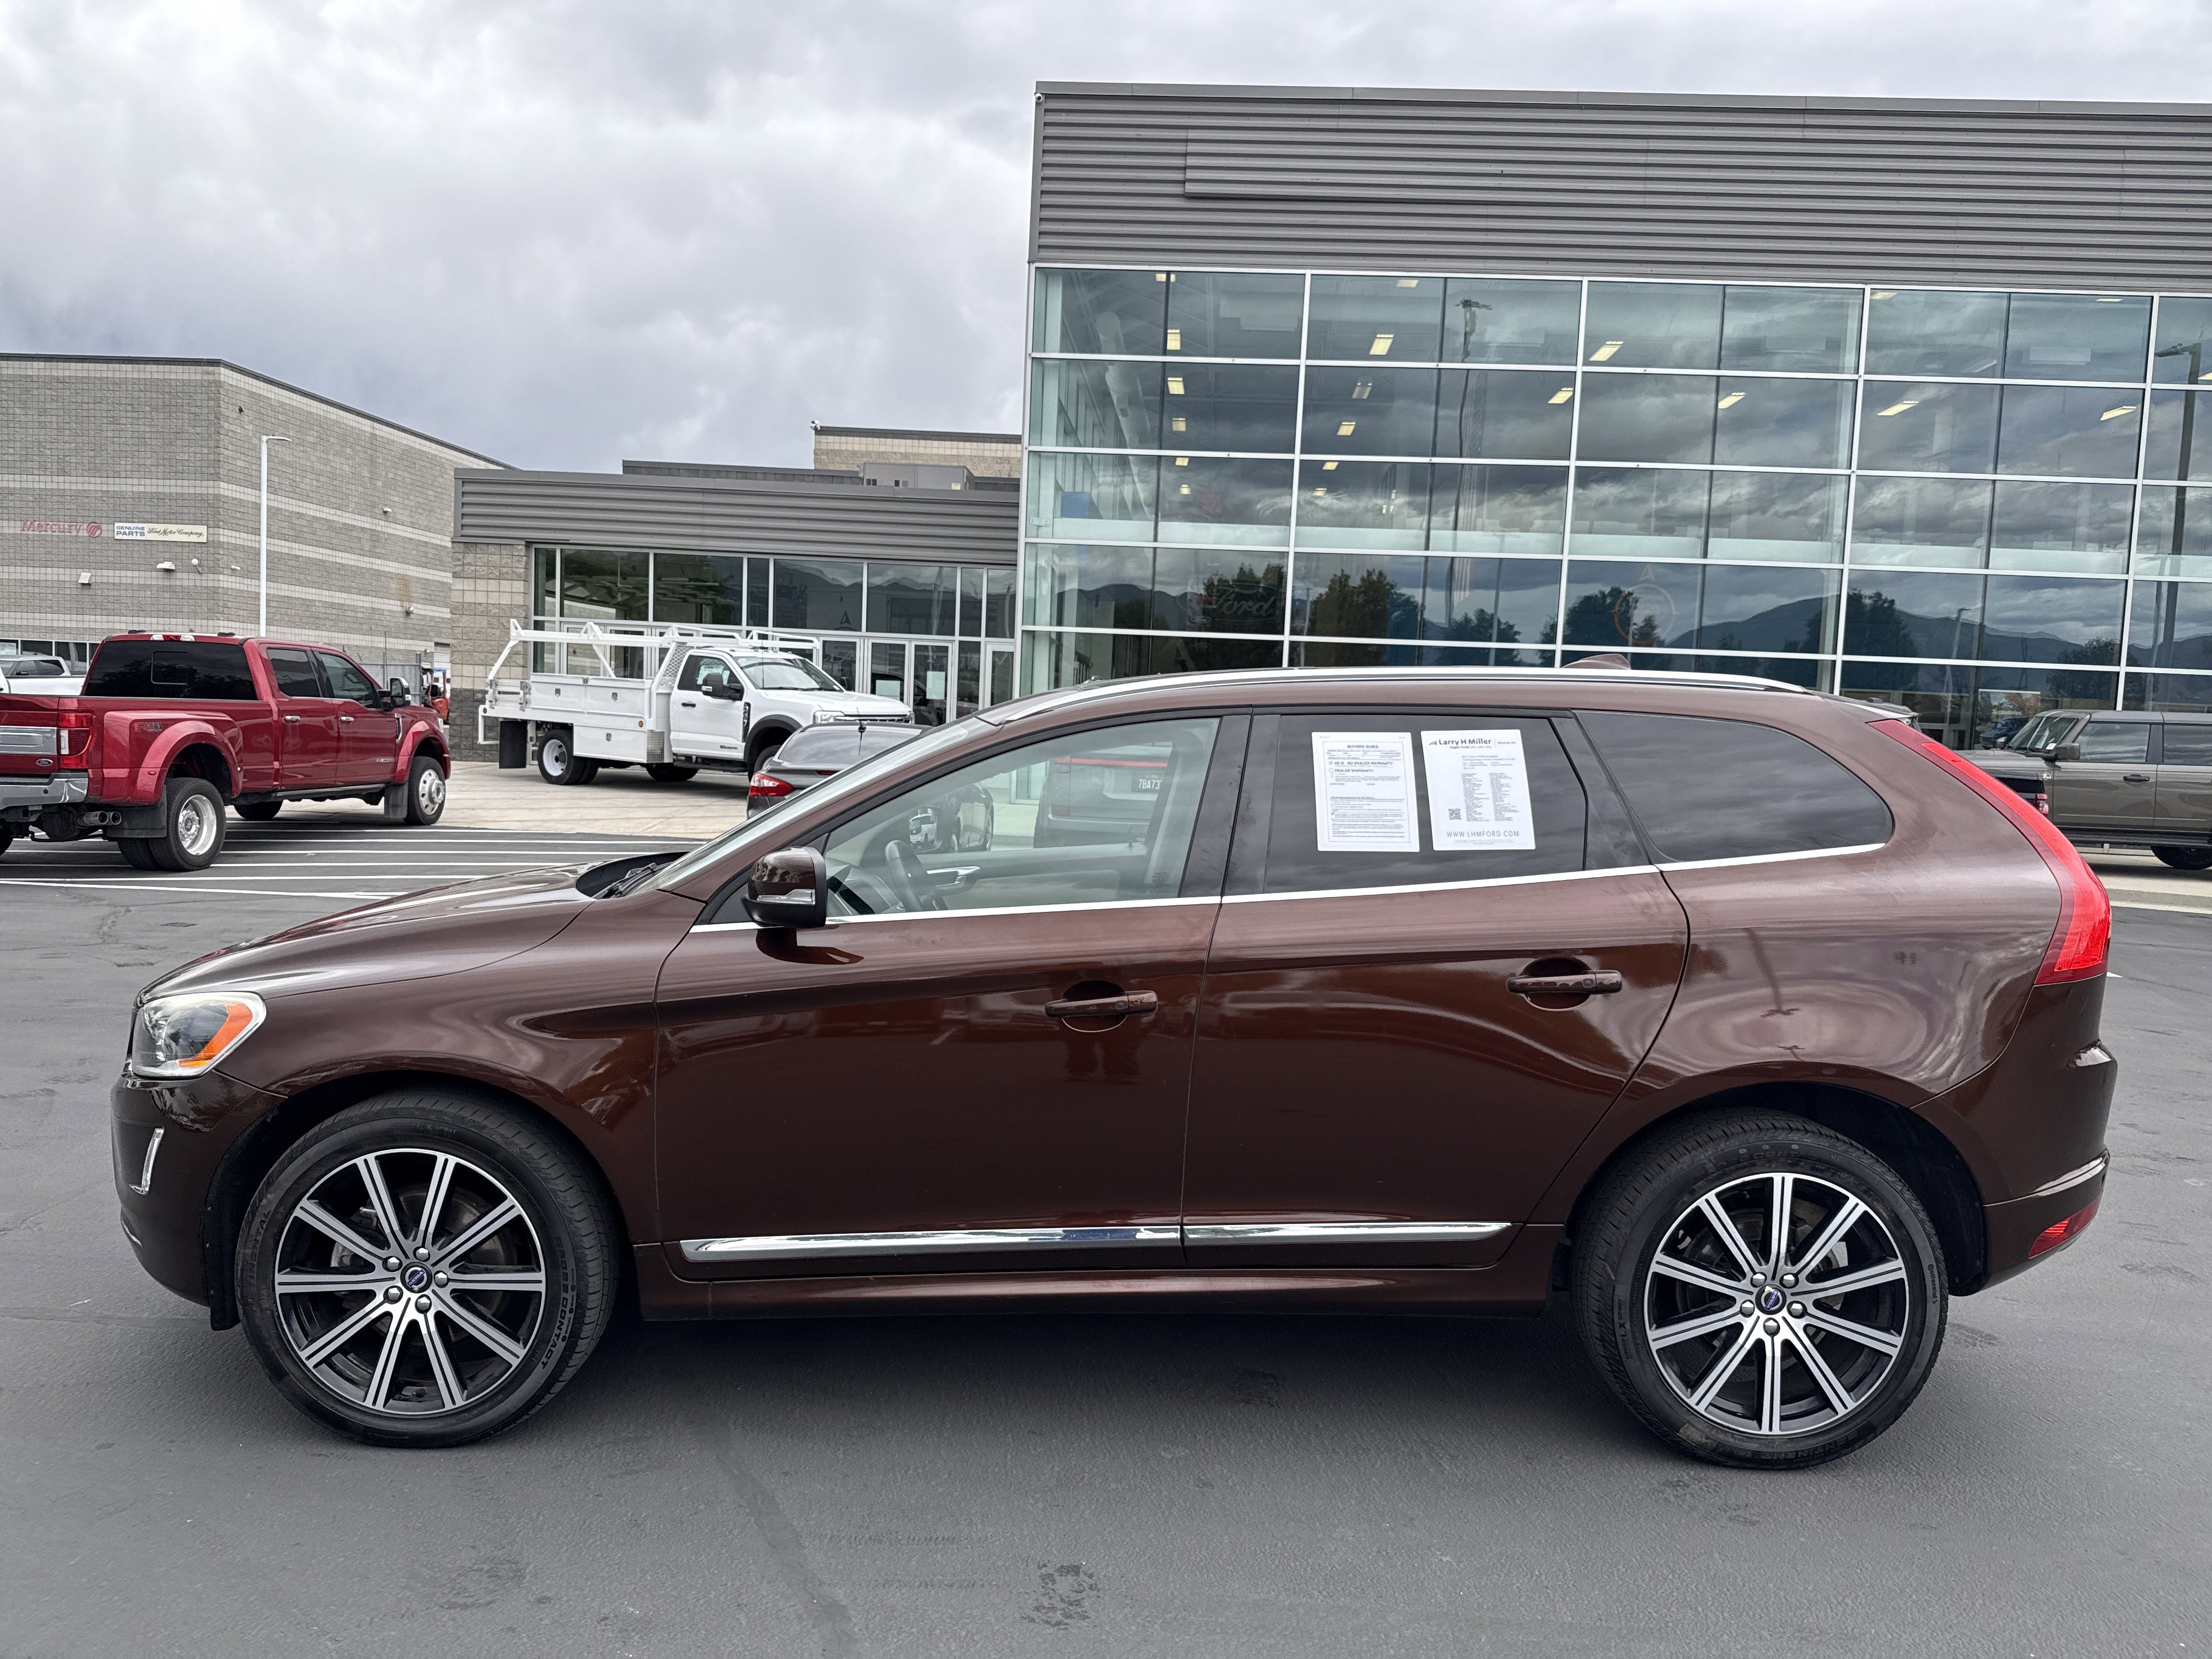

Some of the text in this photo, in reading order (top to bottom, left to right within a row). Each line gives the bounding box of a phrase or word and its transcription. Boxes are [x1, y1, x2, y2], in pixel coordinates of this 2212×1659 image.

[20, 519, 82, 536] Mercury
[160, 528, 176, 536] Motor
[176, 528, 203, 538] Company
[1196, 585, 1278, 616] Ford
[408, 1271, 424, 1285] VOLVO
[1765, 1291, 1778, 1308] VOLVO
[541, 1297, 568, 1369] CONTACT
[1621, 1338, 1630, 1359] CROSS
